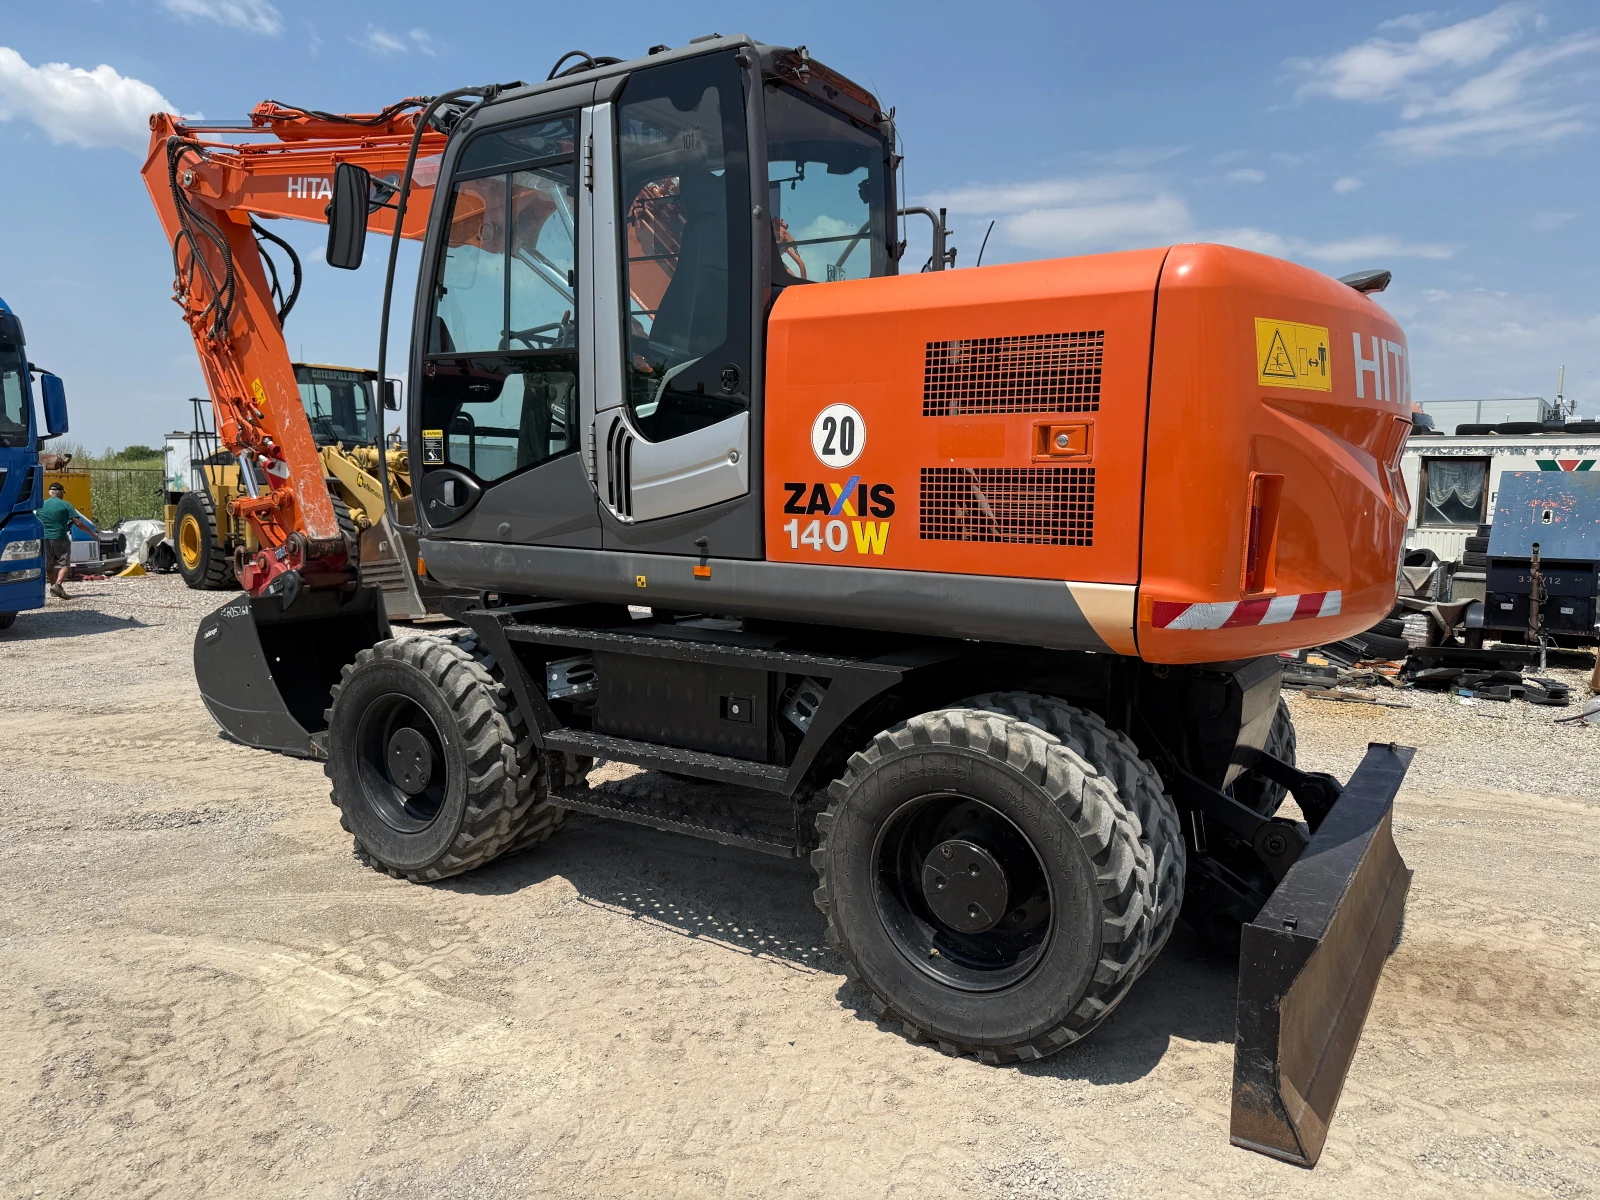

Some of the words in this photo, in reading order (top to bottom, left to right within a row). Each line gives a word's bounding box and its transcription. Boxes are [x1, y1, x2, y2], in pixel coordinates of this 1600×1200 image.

[683, 132, 694, 150] 101
[287, 176, 334, 200] HITA
[311, 369, 358, 382] CATERPILLAR
[821, 415, 856, 457] 20
[783, 475, 896, 519] ZAXIS
